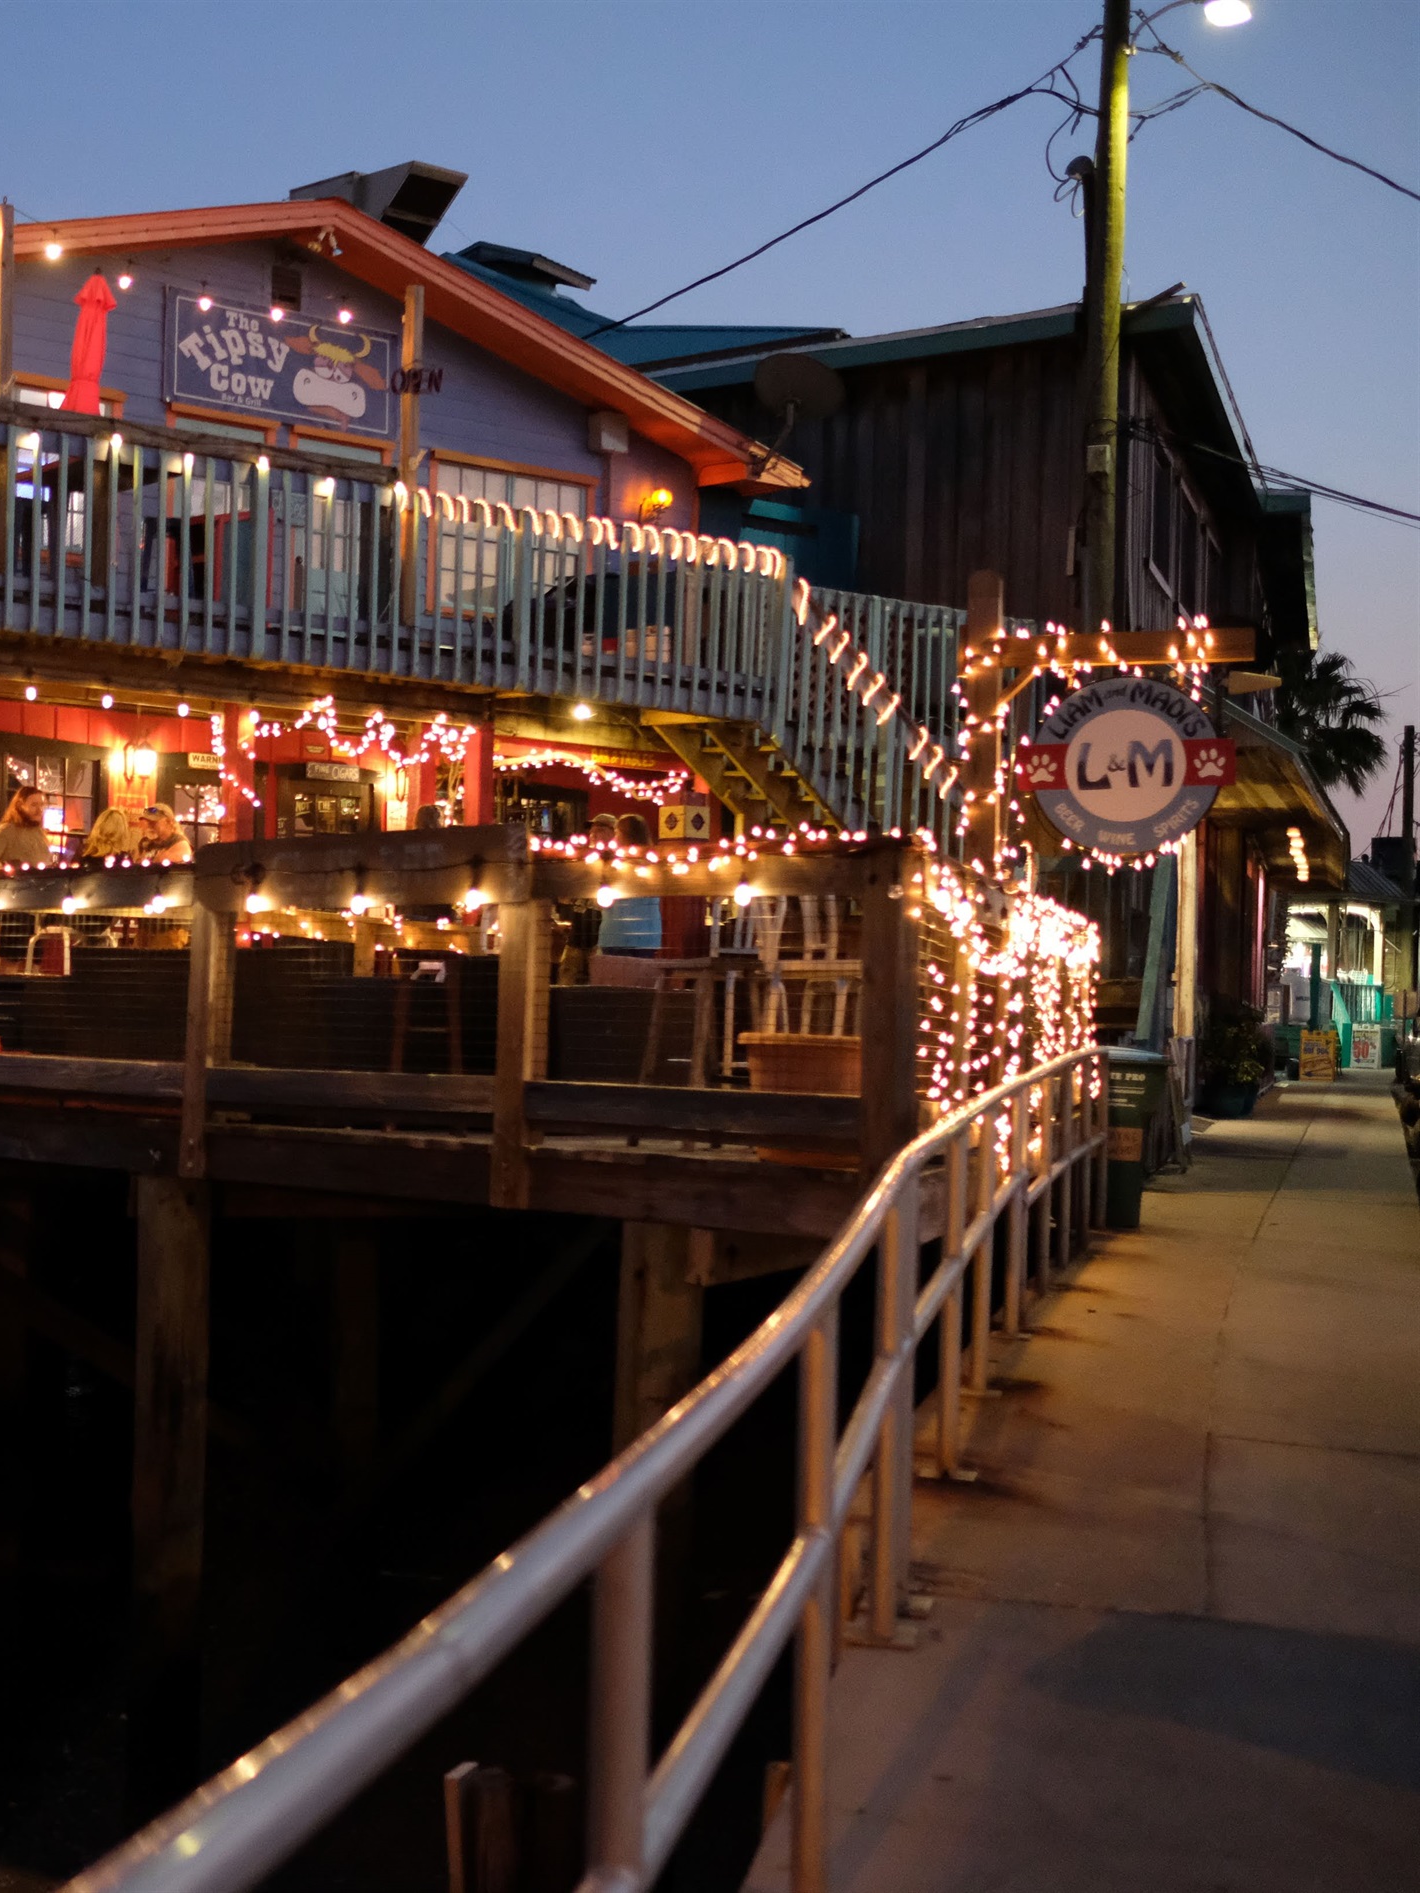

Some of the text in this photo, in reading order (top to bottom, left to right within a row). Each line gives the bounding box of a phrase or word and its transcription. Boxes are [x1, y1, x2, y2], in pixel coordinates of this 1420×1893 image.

[225, 311, 259, 332] The
[179, 325, 291, 373] Tipsy
[209, 363, 275, 401] Cow
[391, 368, 444, 394] OPEN
[221, 393, 235, 402] Bar
[245, 397, 262, 407] Grill
[1047, 688, 1105, 740] LIAM
[1129, 682, 1206, 739] MADI'S
[1054, 802, 1086, 833] BEER
[1152, 799, 1199, 839] SPIRITS
[1097, 829, 1136, 846] WINE
